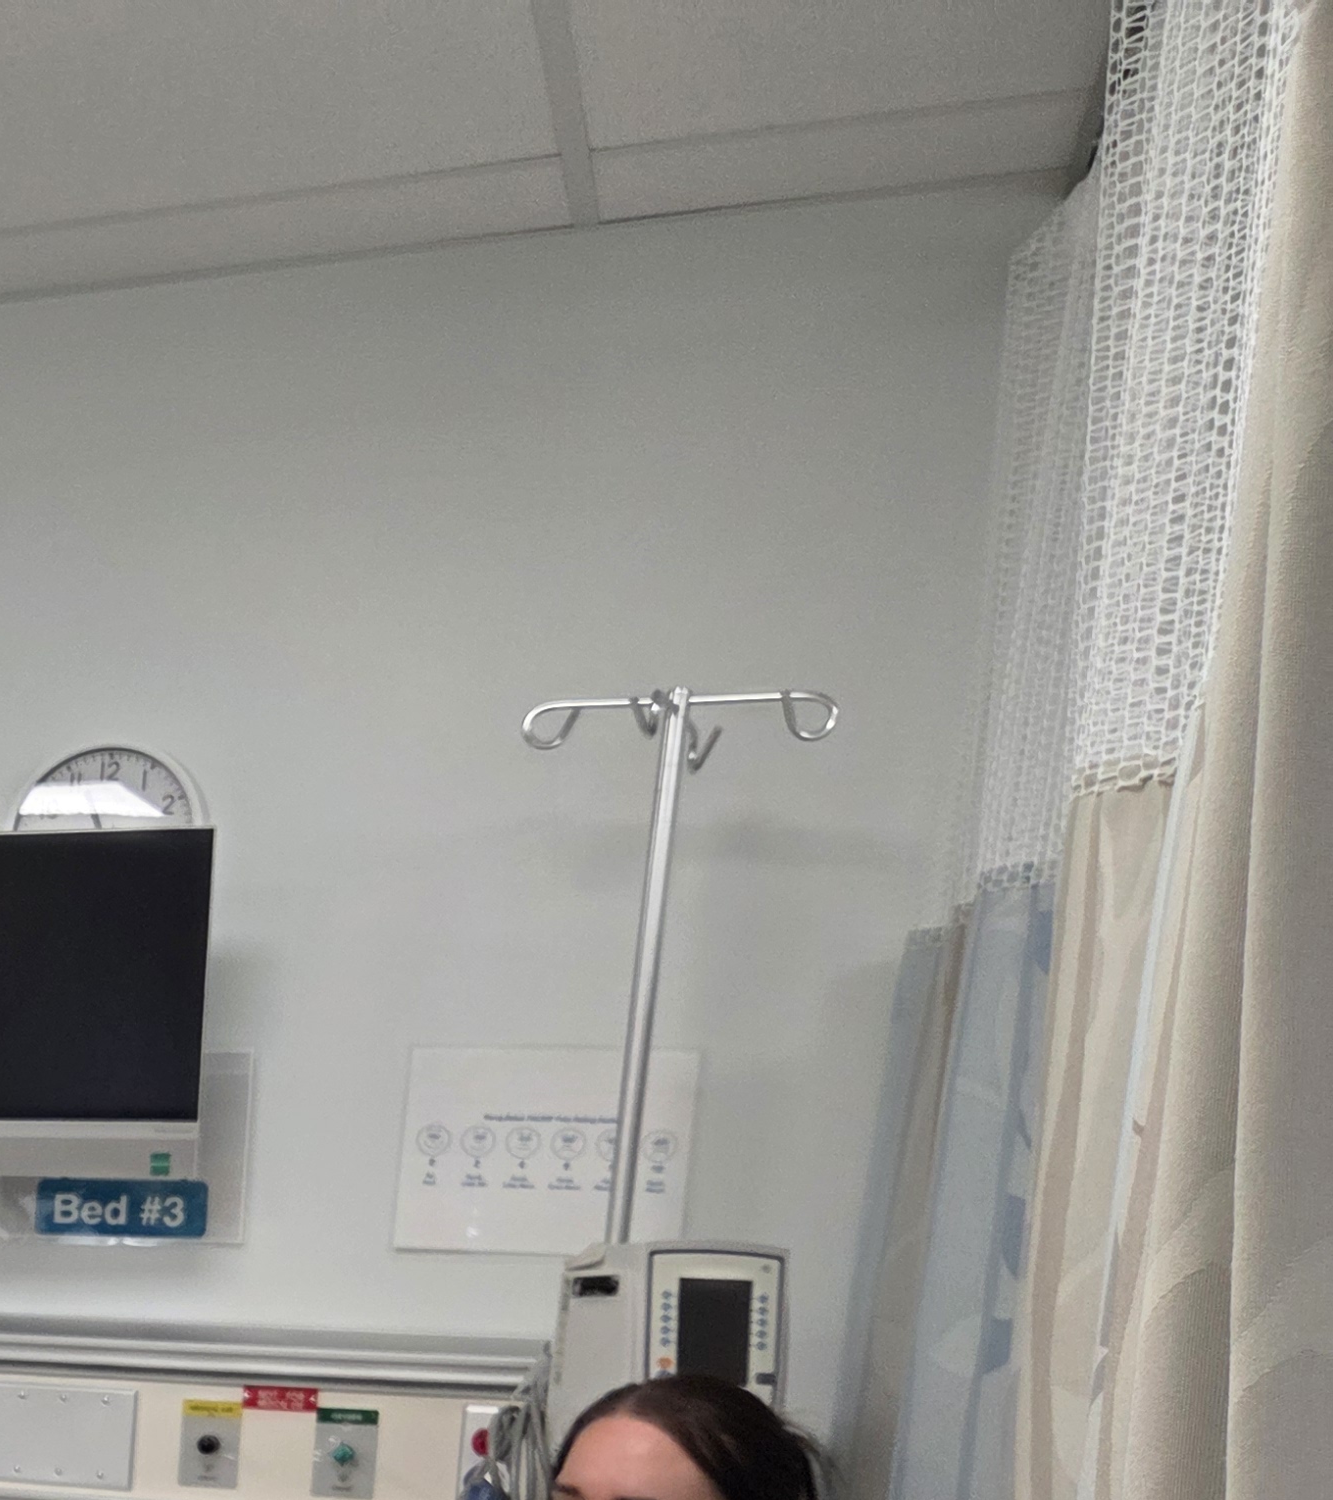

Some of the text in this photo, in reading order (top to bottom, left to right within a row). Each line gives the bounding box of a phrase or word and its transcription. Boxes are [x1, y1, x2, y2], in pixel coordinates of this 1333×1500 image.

[100, 760, 120, 781] 12
[141, 769, 148, 792] 1
[162, 794, 175, 816] 2
[52, 1192, 185, 1229] Bed #3
